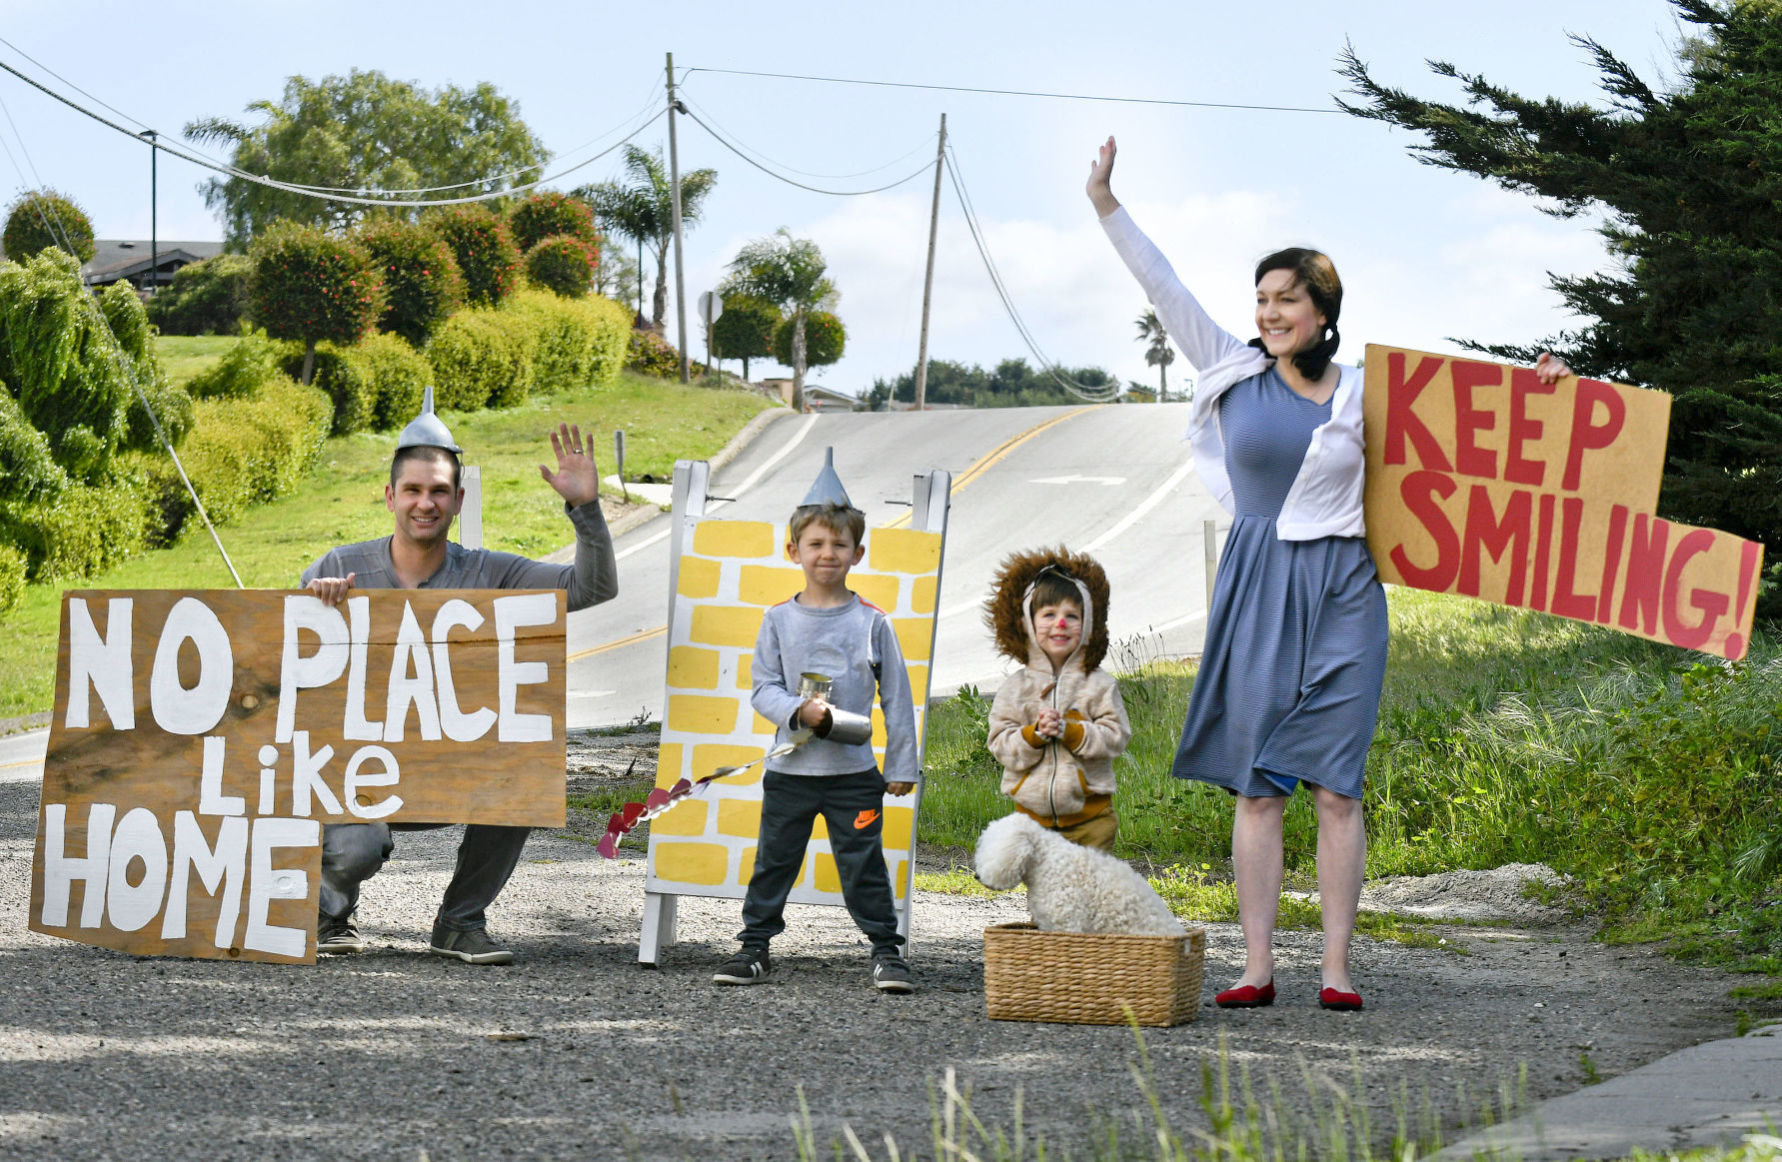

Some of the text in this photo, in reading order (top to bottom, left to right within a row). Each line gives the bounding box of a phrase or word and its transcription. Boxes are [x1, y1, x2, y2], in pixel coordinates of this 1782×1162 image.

[1384, 352, 1626, 491] KEEP
[1389, 470, 1764, 660] SMILING!
[65, 594, 557, 743] NO PLACE
[200, 730, 404, 819] Like
[41, 802, 320, 957] HOME
